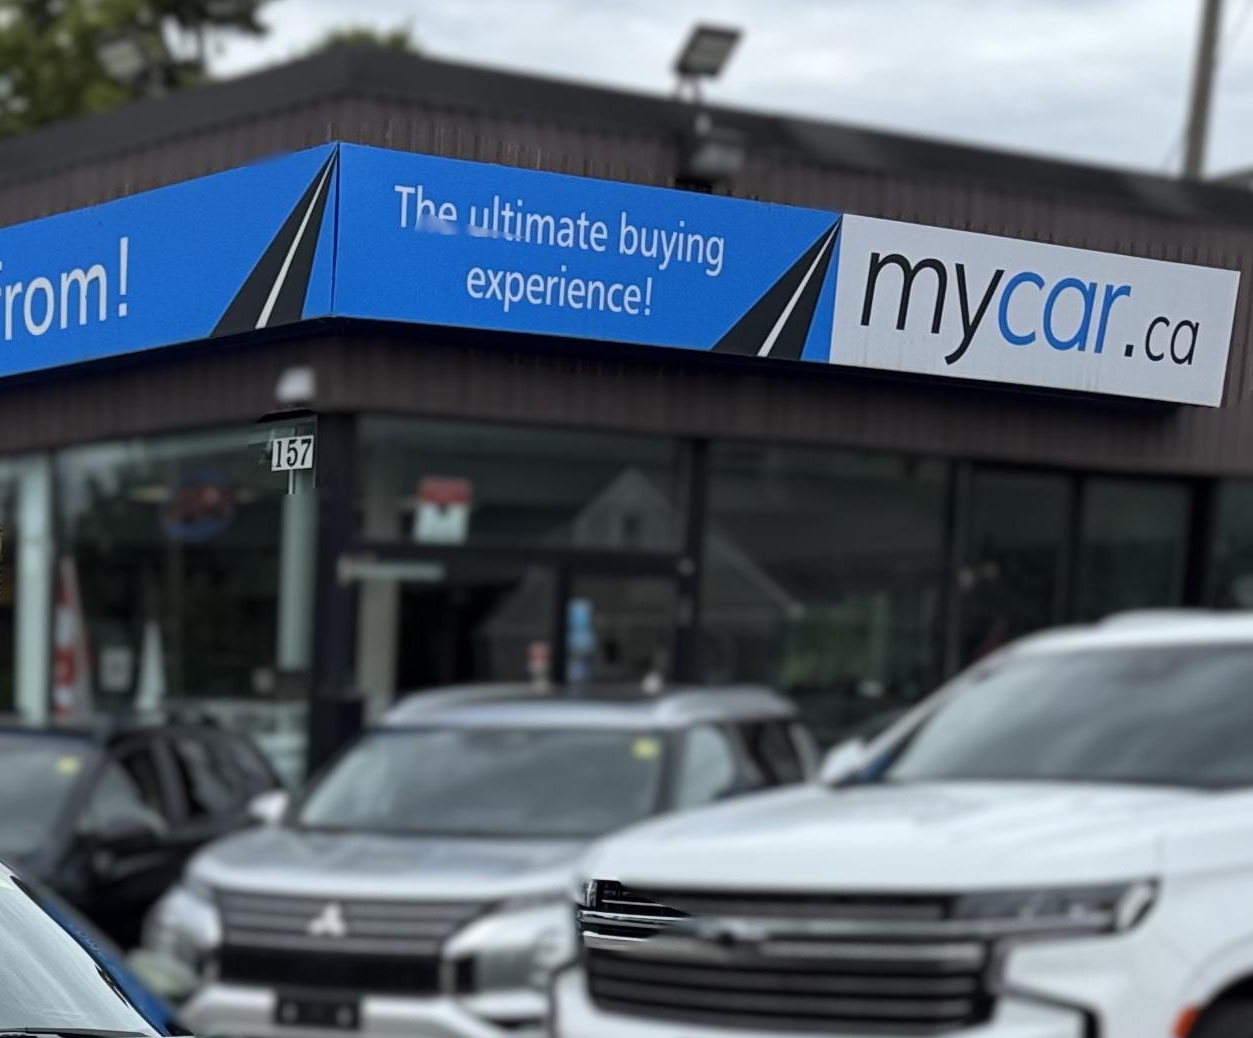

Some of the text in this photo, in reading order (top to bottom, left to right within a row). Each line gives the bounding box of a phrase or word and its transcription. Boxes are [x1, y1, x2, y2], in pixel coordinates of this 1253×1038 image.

[394, 184, 725, 277] The ultimate buying
[466, 265, 653, 316] experience!
[859, 251, 1200, 366] mycar.ca
[274, 438, 312, 469] 157
